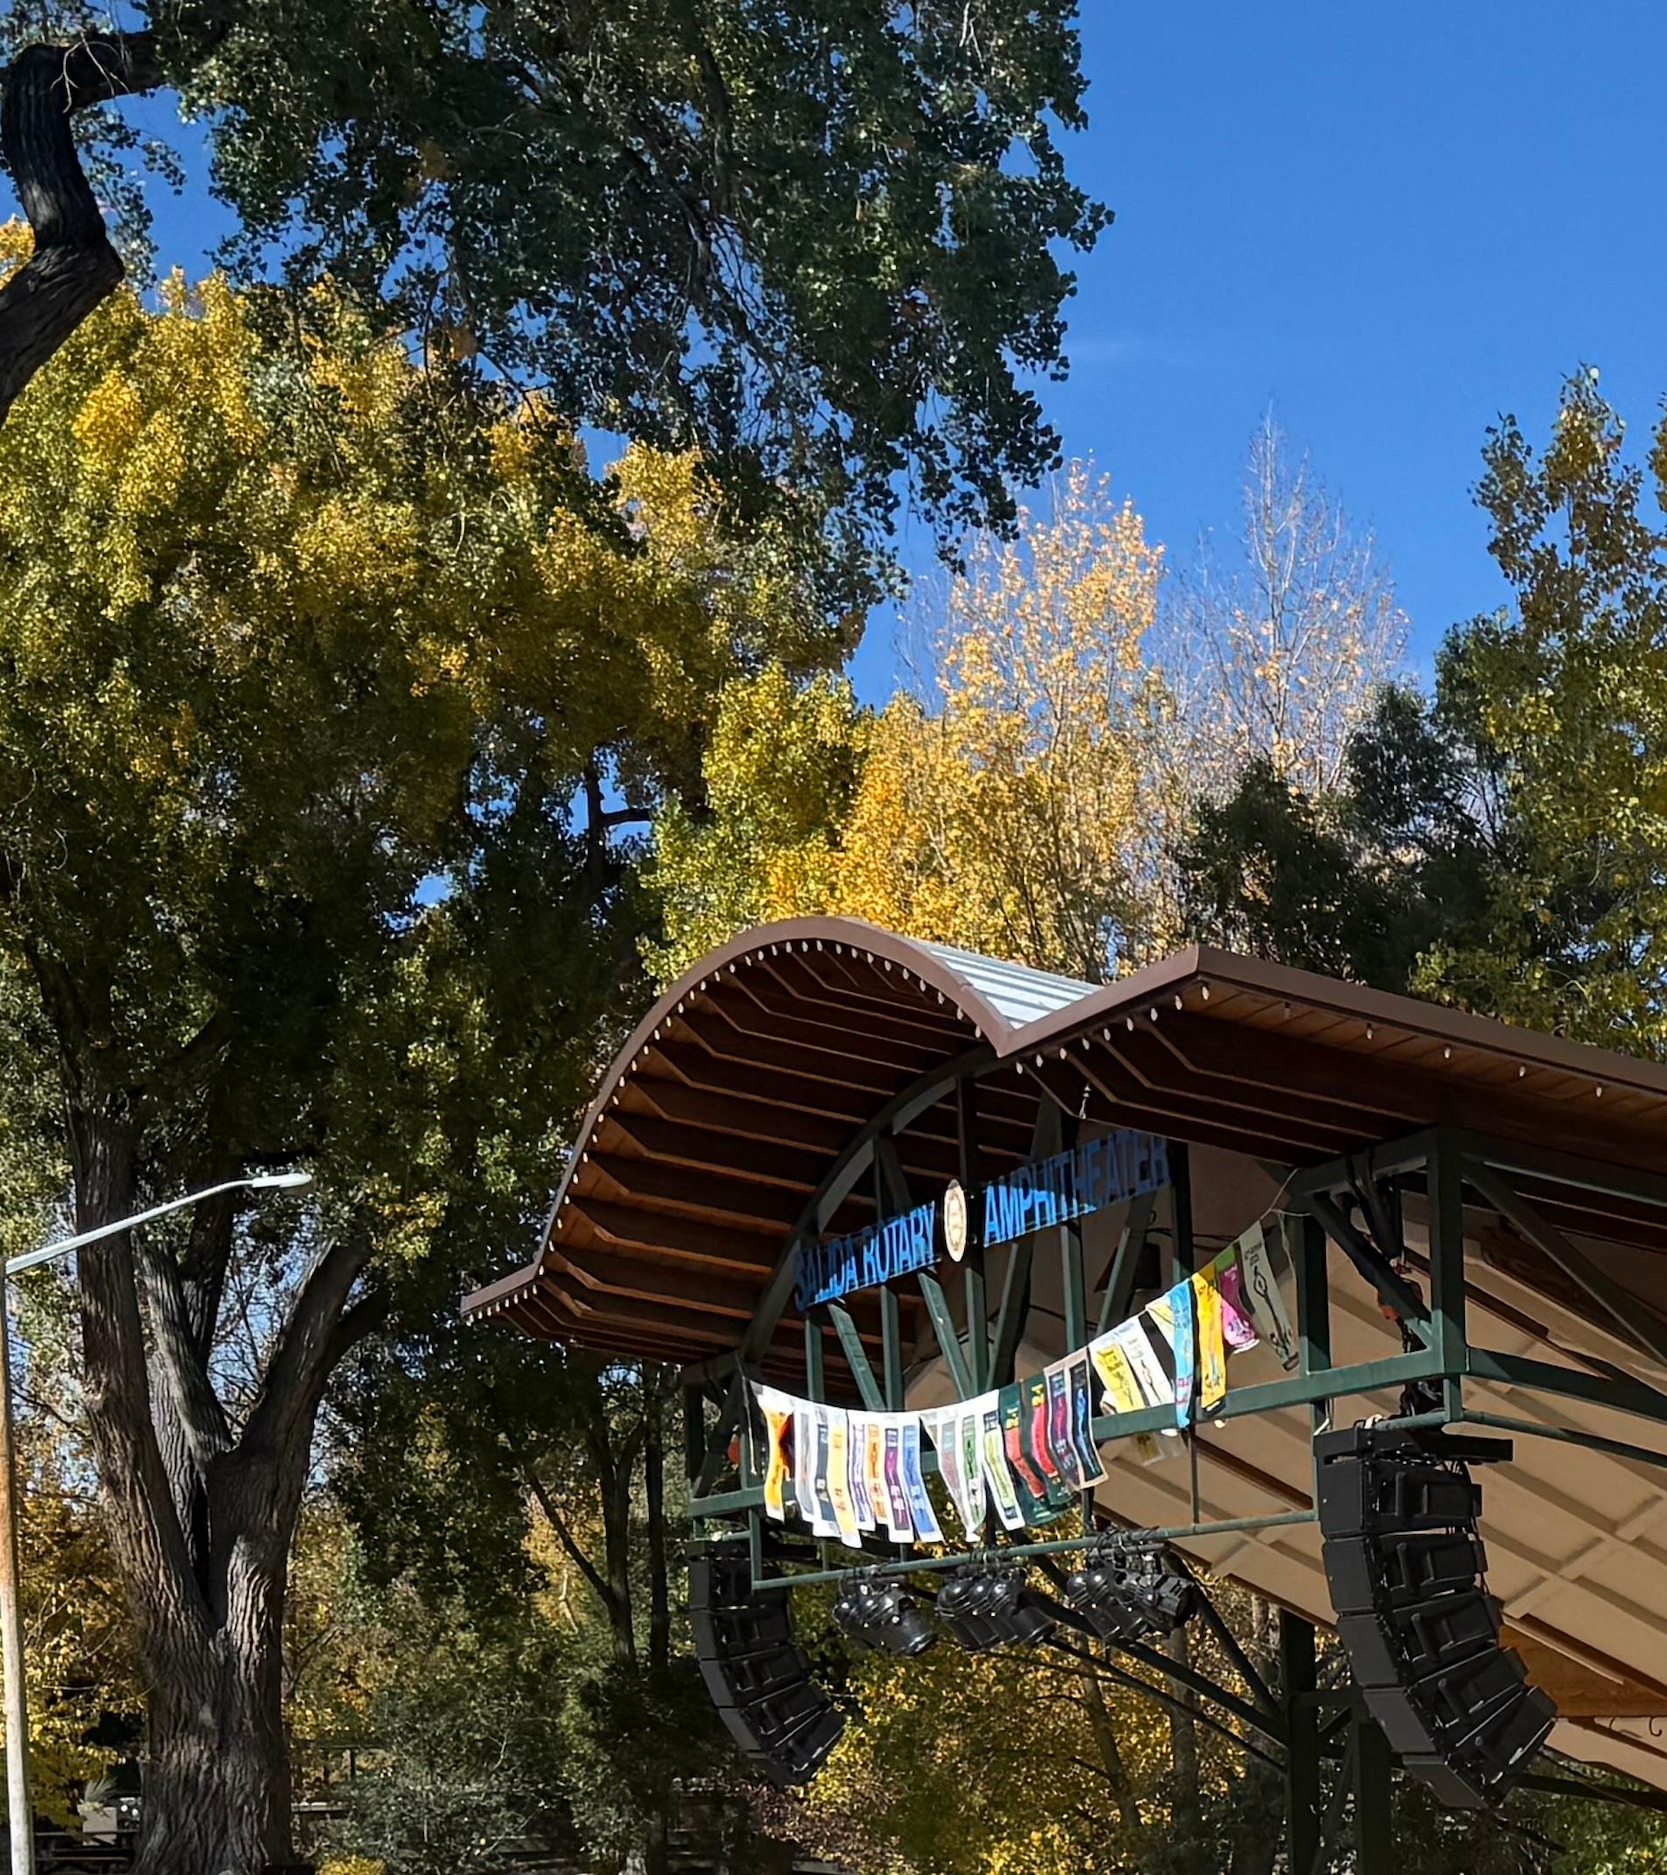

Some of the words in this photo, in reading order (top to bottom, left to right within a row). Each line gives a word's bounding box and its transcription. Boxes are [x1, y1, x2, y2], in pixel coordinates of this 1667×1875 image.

[794, 1233, 859, 1312] SALIDA
[862, 1200, 936, 1286] ROTARY
[983, 1129, 1172, 1248] AMPHITHEATER
